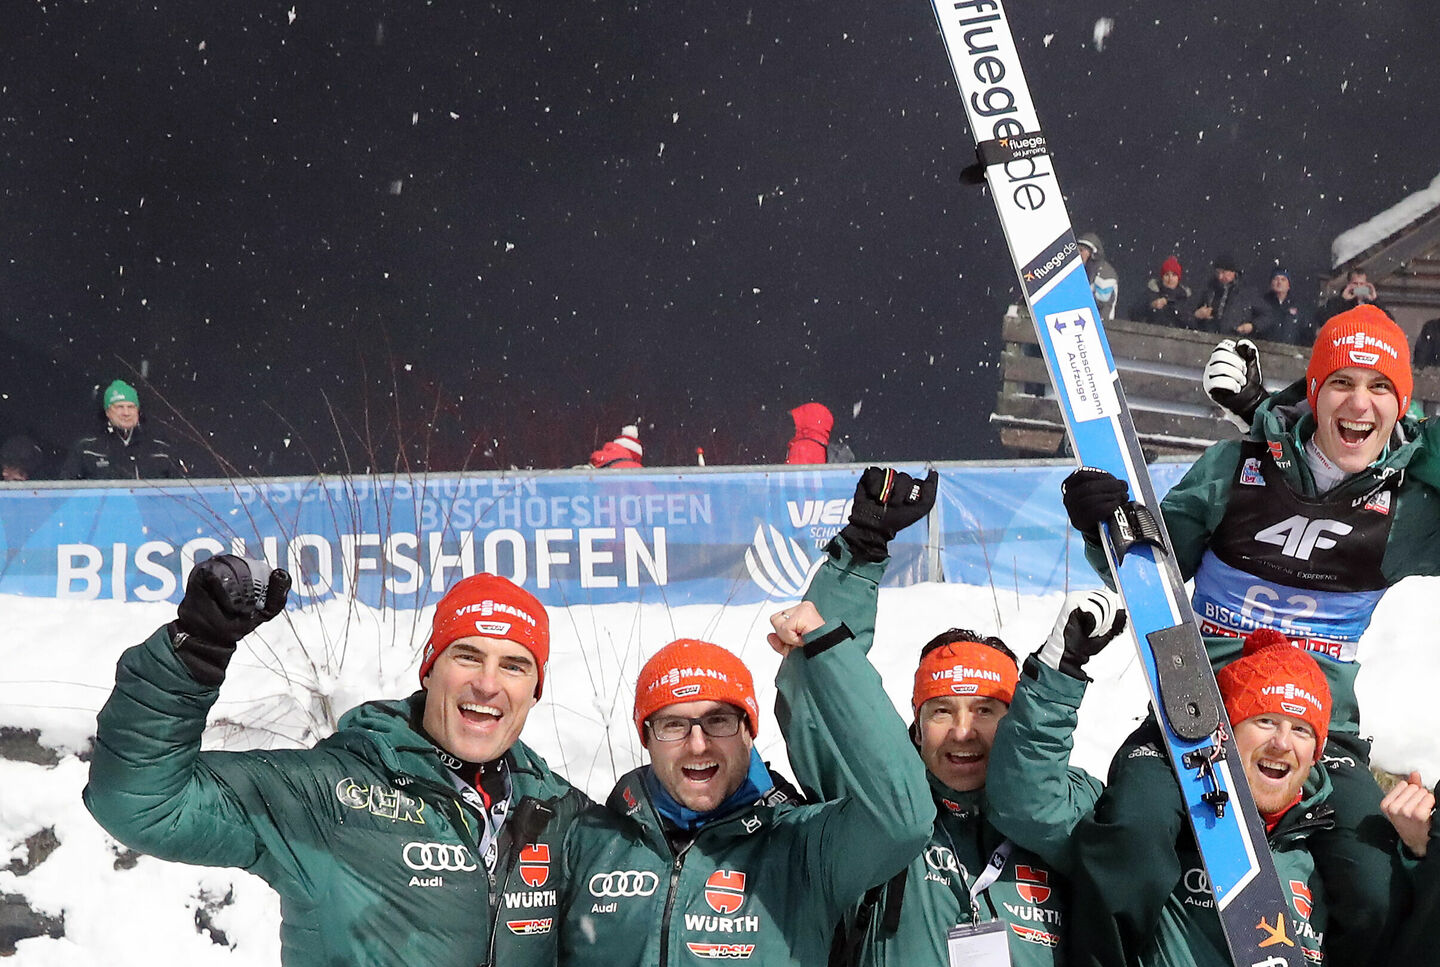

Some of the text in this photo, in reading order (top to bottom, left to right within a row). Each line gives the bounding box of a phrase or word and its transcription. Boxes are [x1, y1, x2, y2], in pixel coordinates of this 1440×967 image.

[1033, 241, 1077, 279] fluege.de
[1332, 332, 1398, 360] VIESSMANN
[1067, 352, 1087, 402] Aufzüge
[1074, 334, 1103, 415] Hübschmann
[422, 492, 711, 529] BISCHOFSHOFEN
[1254, 514, 1353, 560] 4F
[455, 599, 536, 627] VIESSMANN
[1241, 585, 1318, 632] 62
[647, 668, 728, 692] VIESSMANN
[932, 664, 1001, 683] VIESSMANN
[1261, 684, 1322, 711] VIESSMANN
[336, 777, 426, 824] GER
[409, 876, 443, 887] Audi
[924, 871, 951, 887] Audi
[505, 890, 556, 909] WÜRTH
[591, 903, 617, 914] Audi
[1185, 896, 1213, 908] Audi
[684, 913, 759, 933] WÜRTH
